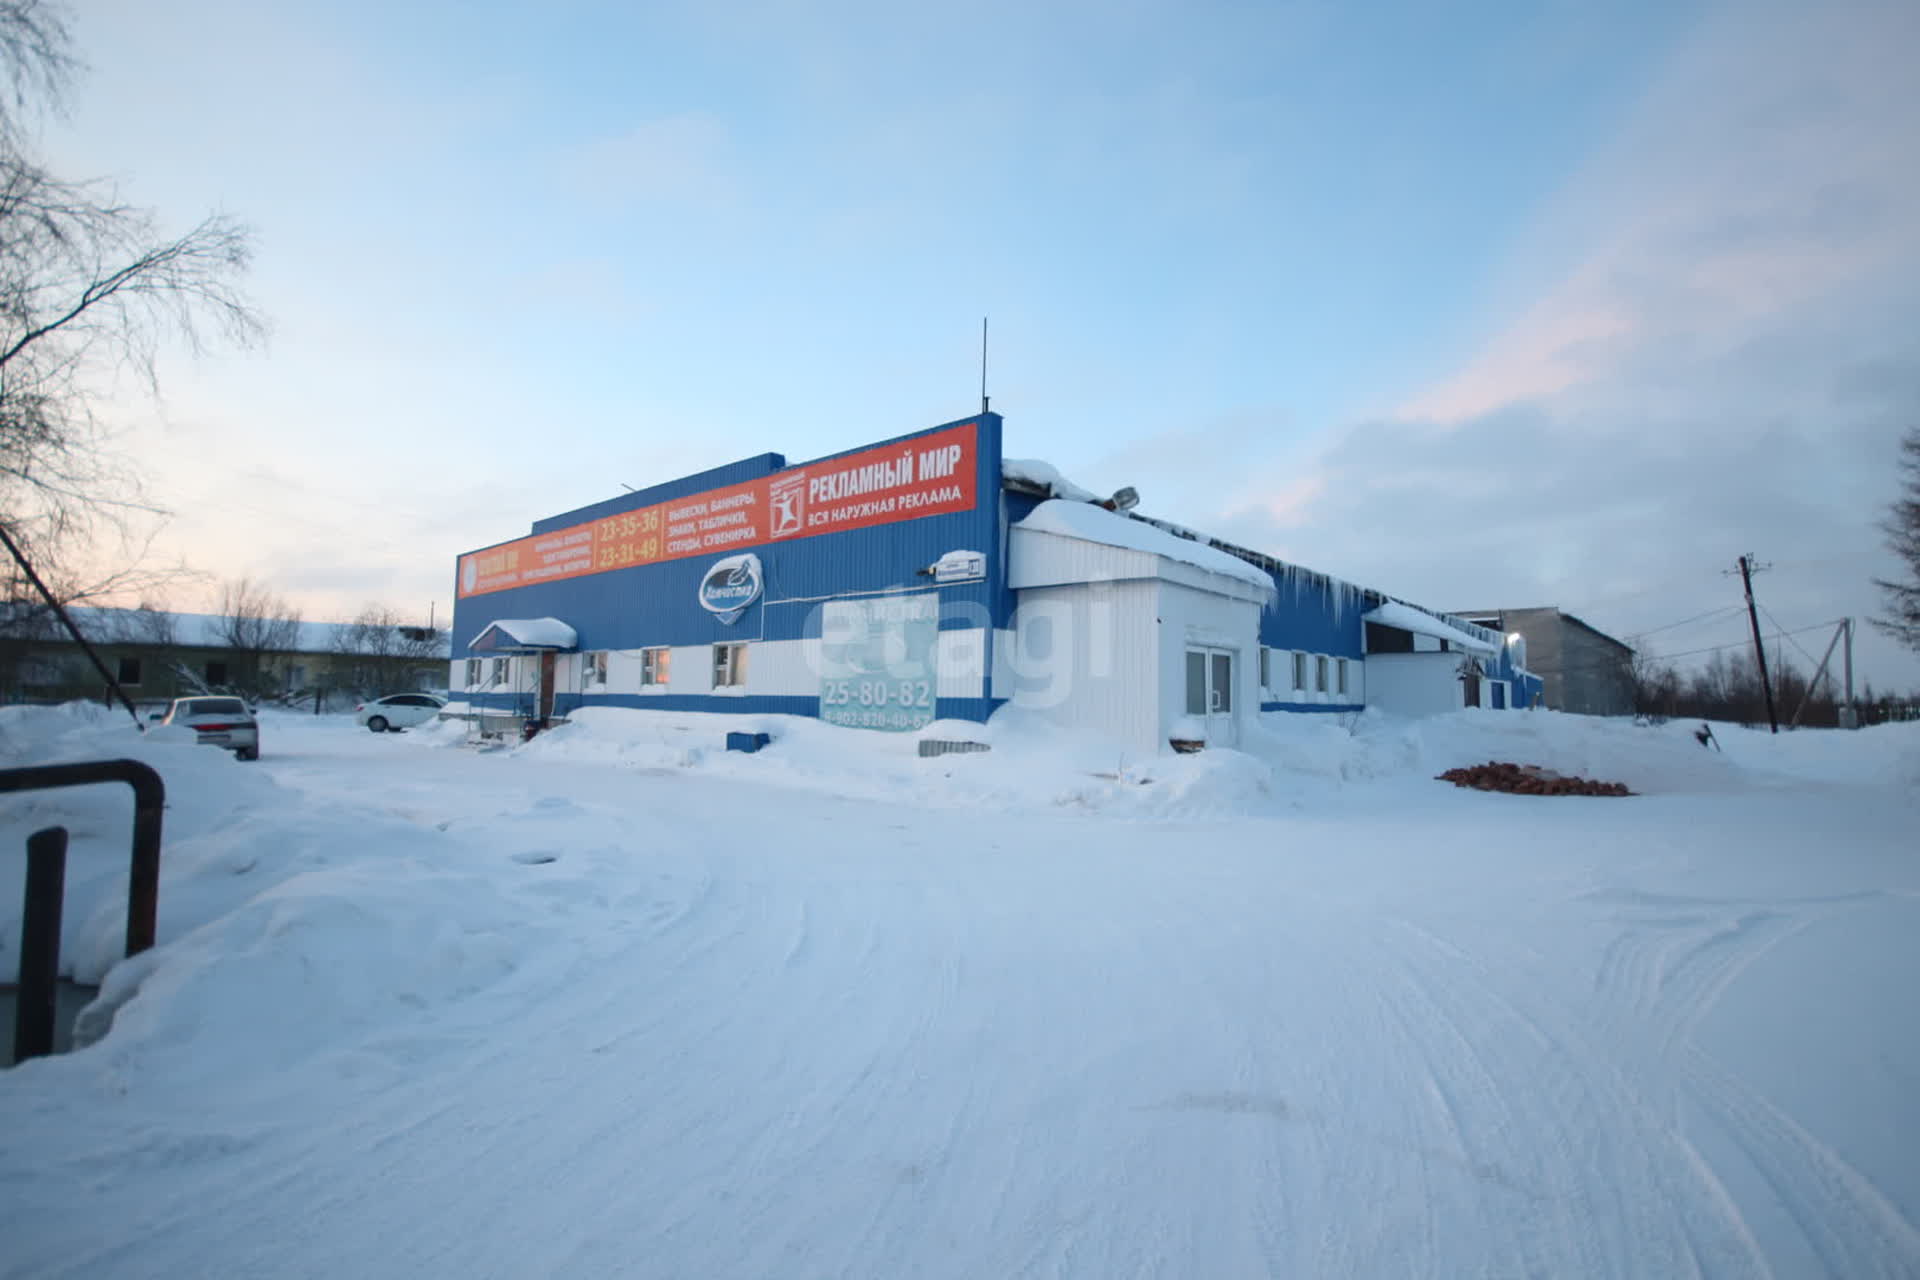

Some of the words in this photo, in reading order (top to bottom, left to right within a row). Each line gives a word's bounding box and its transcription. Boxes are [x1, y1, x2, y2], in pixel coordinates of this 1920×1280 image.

[809, 450, 914, 504] РЕКЛАМНЫЙ
[919, 444, 962, 481] МИР
[808, 511, 829, 527] ВСЯ
[831, 498, 896, 523] НАРУЖНАЯ
[898, 485, 962, 510] РЕКЛАМА
[600, 510, 658, 542] 23-35-36
[600, 537, 657, 567] 23-31-49
[824, 681, 930, 707] 25-80-82
